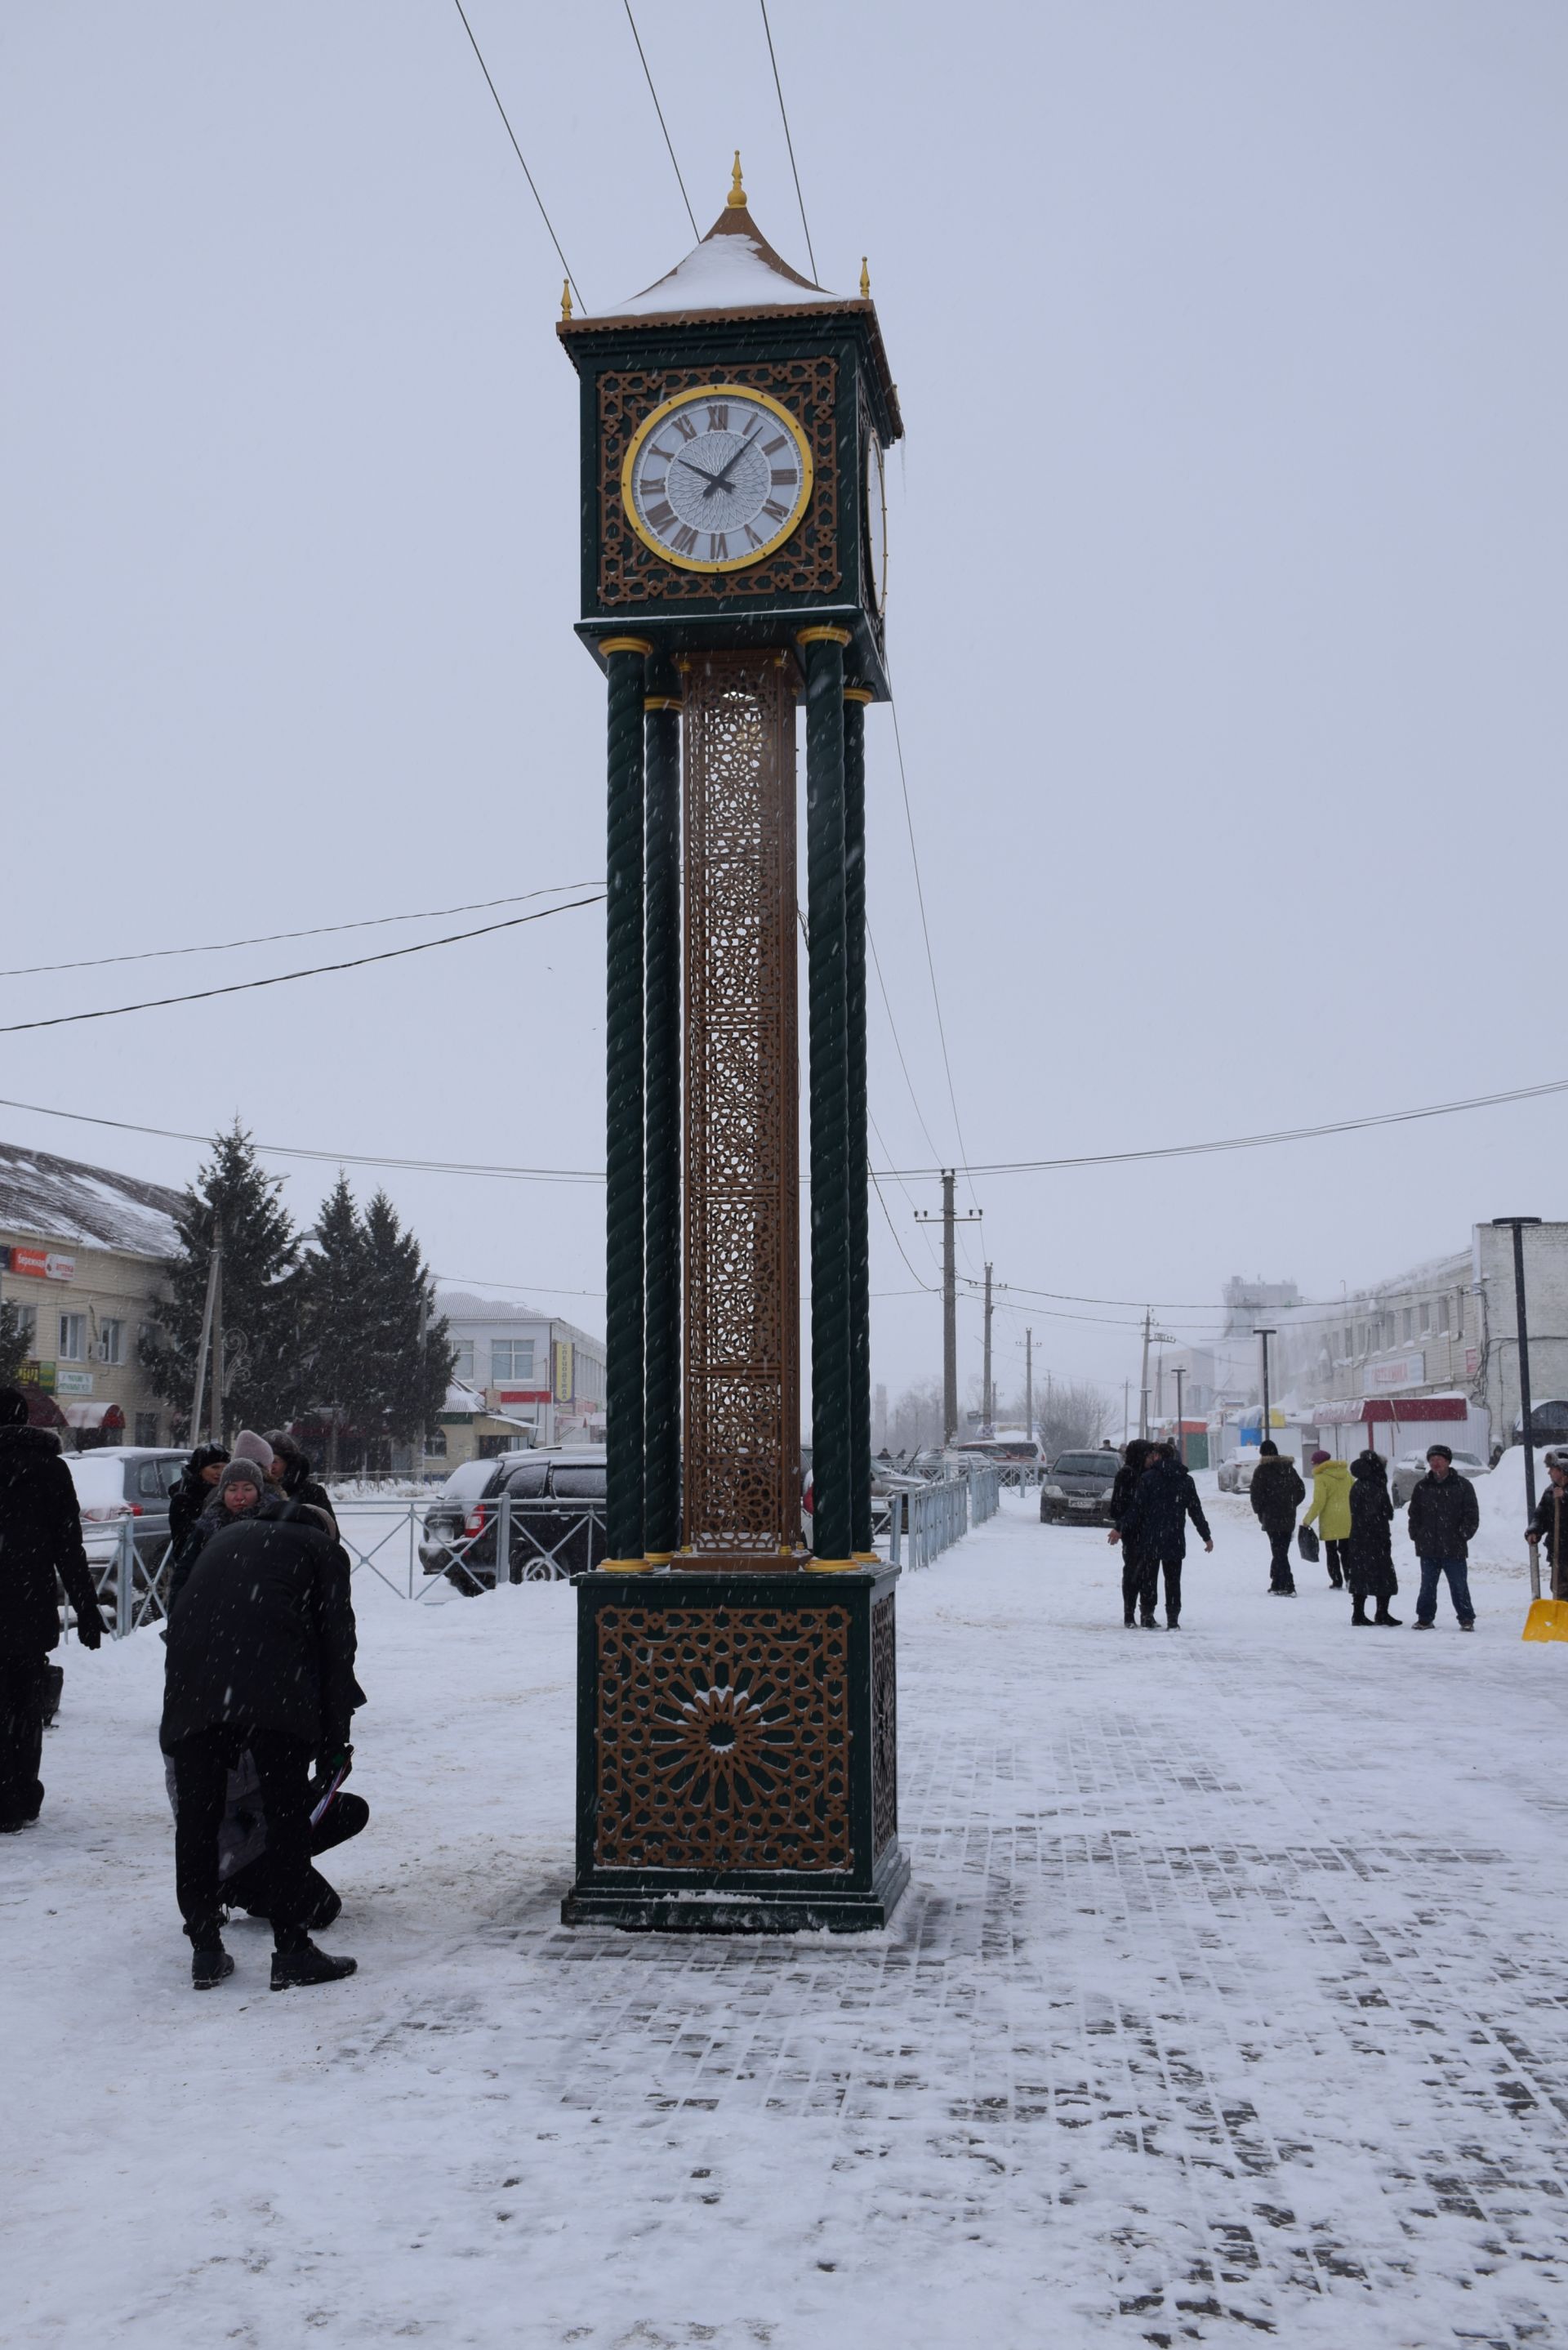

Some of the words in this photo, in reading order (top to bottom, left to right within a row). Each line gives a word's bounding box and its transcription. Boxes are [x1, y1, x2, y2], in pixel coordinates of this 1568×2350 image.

[671, 414, 697, 442] XI
[707, 404, 729, 431] XII
[648, 444, 675, 462] X
[762, 435, 788, 457] II
[640, 477, 666, 495] IX
[771, 469, 797, 485] III
[644, 500, 678, 535] VIII
[762, 498, 790, 524] IV
[670, 524, 699, 555] VII
[710, 533, 728, 560] VI
